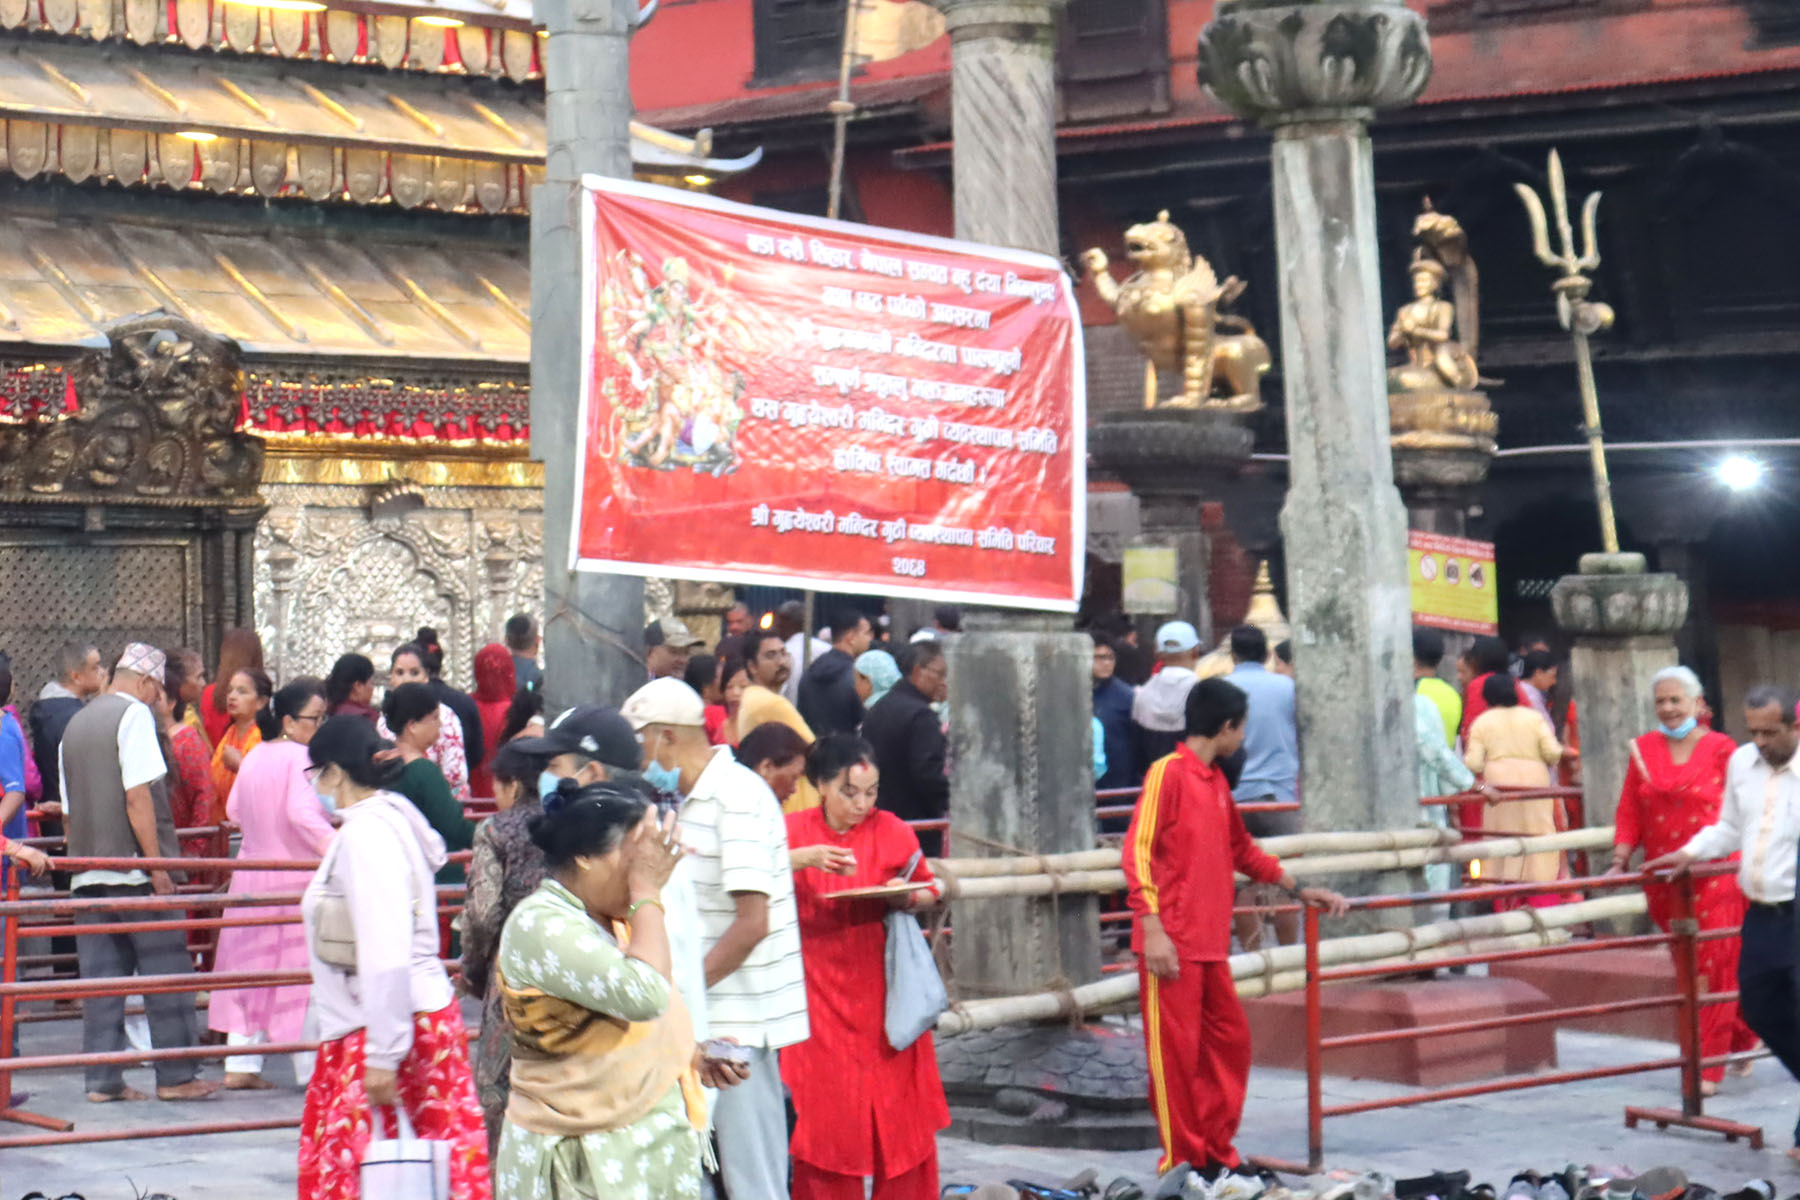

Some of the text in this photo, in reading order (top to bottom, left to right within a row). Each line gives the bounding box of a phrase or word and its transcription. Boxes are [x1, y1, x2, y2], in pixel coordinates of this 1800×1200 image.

[859, 248, 903, 277] नेपाल
[750, 397, 779, 422] यस
[942, 421, 1014, 448] व्यवस्थापन
[1016, 426, 1058, 455] समिति
[751, 503, 770, 527] श्री
[837, 512, 879, 539] मन्दिर
[881, 517, 907, 544] गुठी
[976, 526, 1014, 551] समिति
[1016, 530, 1056, 555] परिवार
